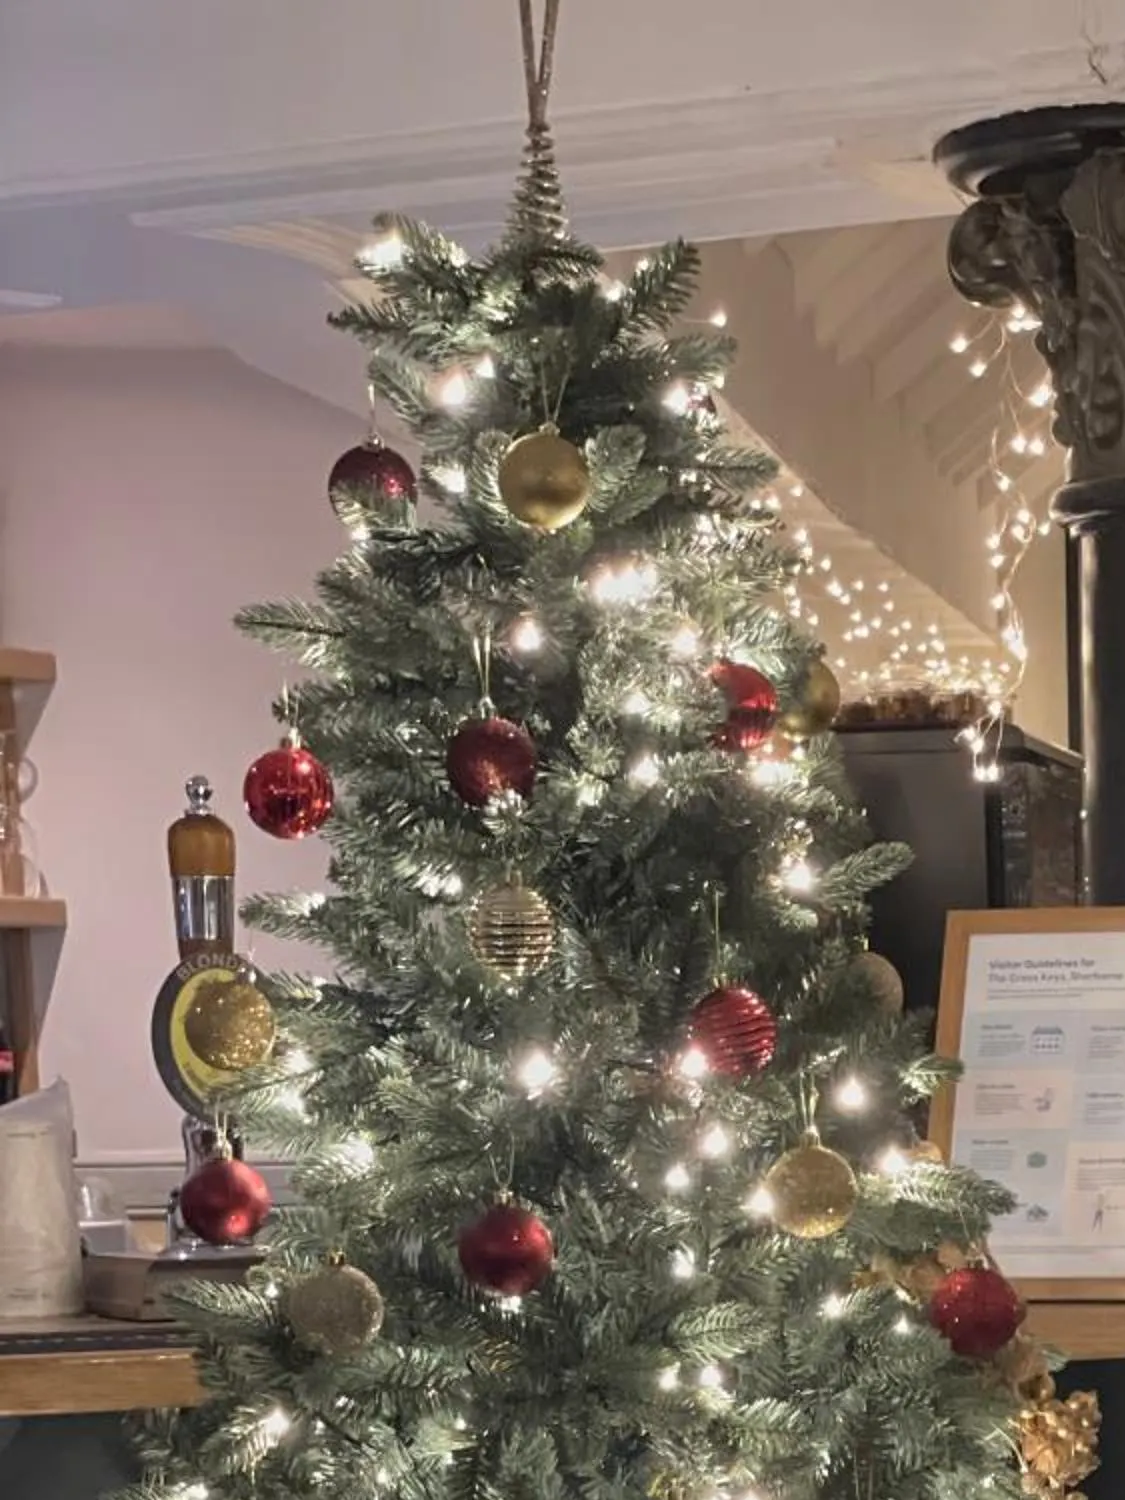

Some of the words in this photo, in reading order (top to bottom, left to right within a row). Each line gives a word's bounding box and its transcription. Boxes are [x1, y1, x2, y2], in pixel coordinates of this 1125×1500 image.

[176, 953, 247, 982] BLOND
[988, 959, 1022, 969] Visitor
[1024, 958, 1078, 968] Guidelines
[1080, 957, 1095, 967] for
[988, 973, 1006, 983] The
[1009, 972, 1038, 982] Cross
